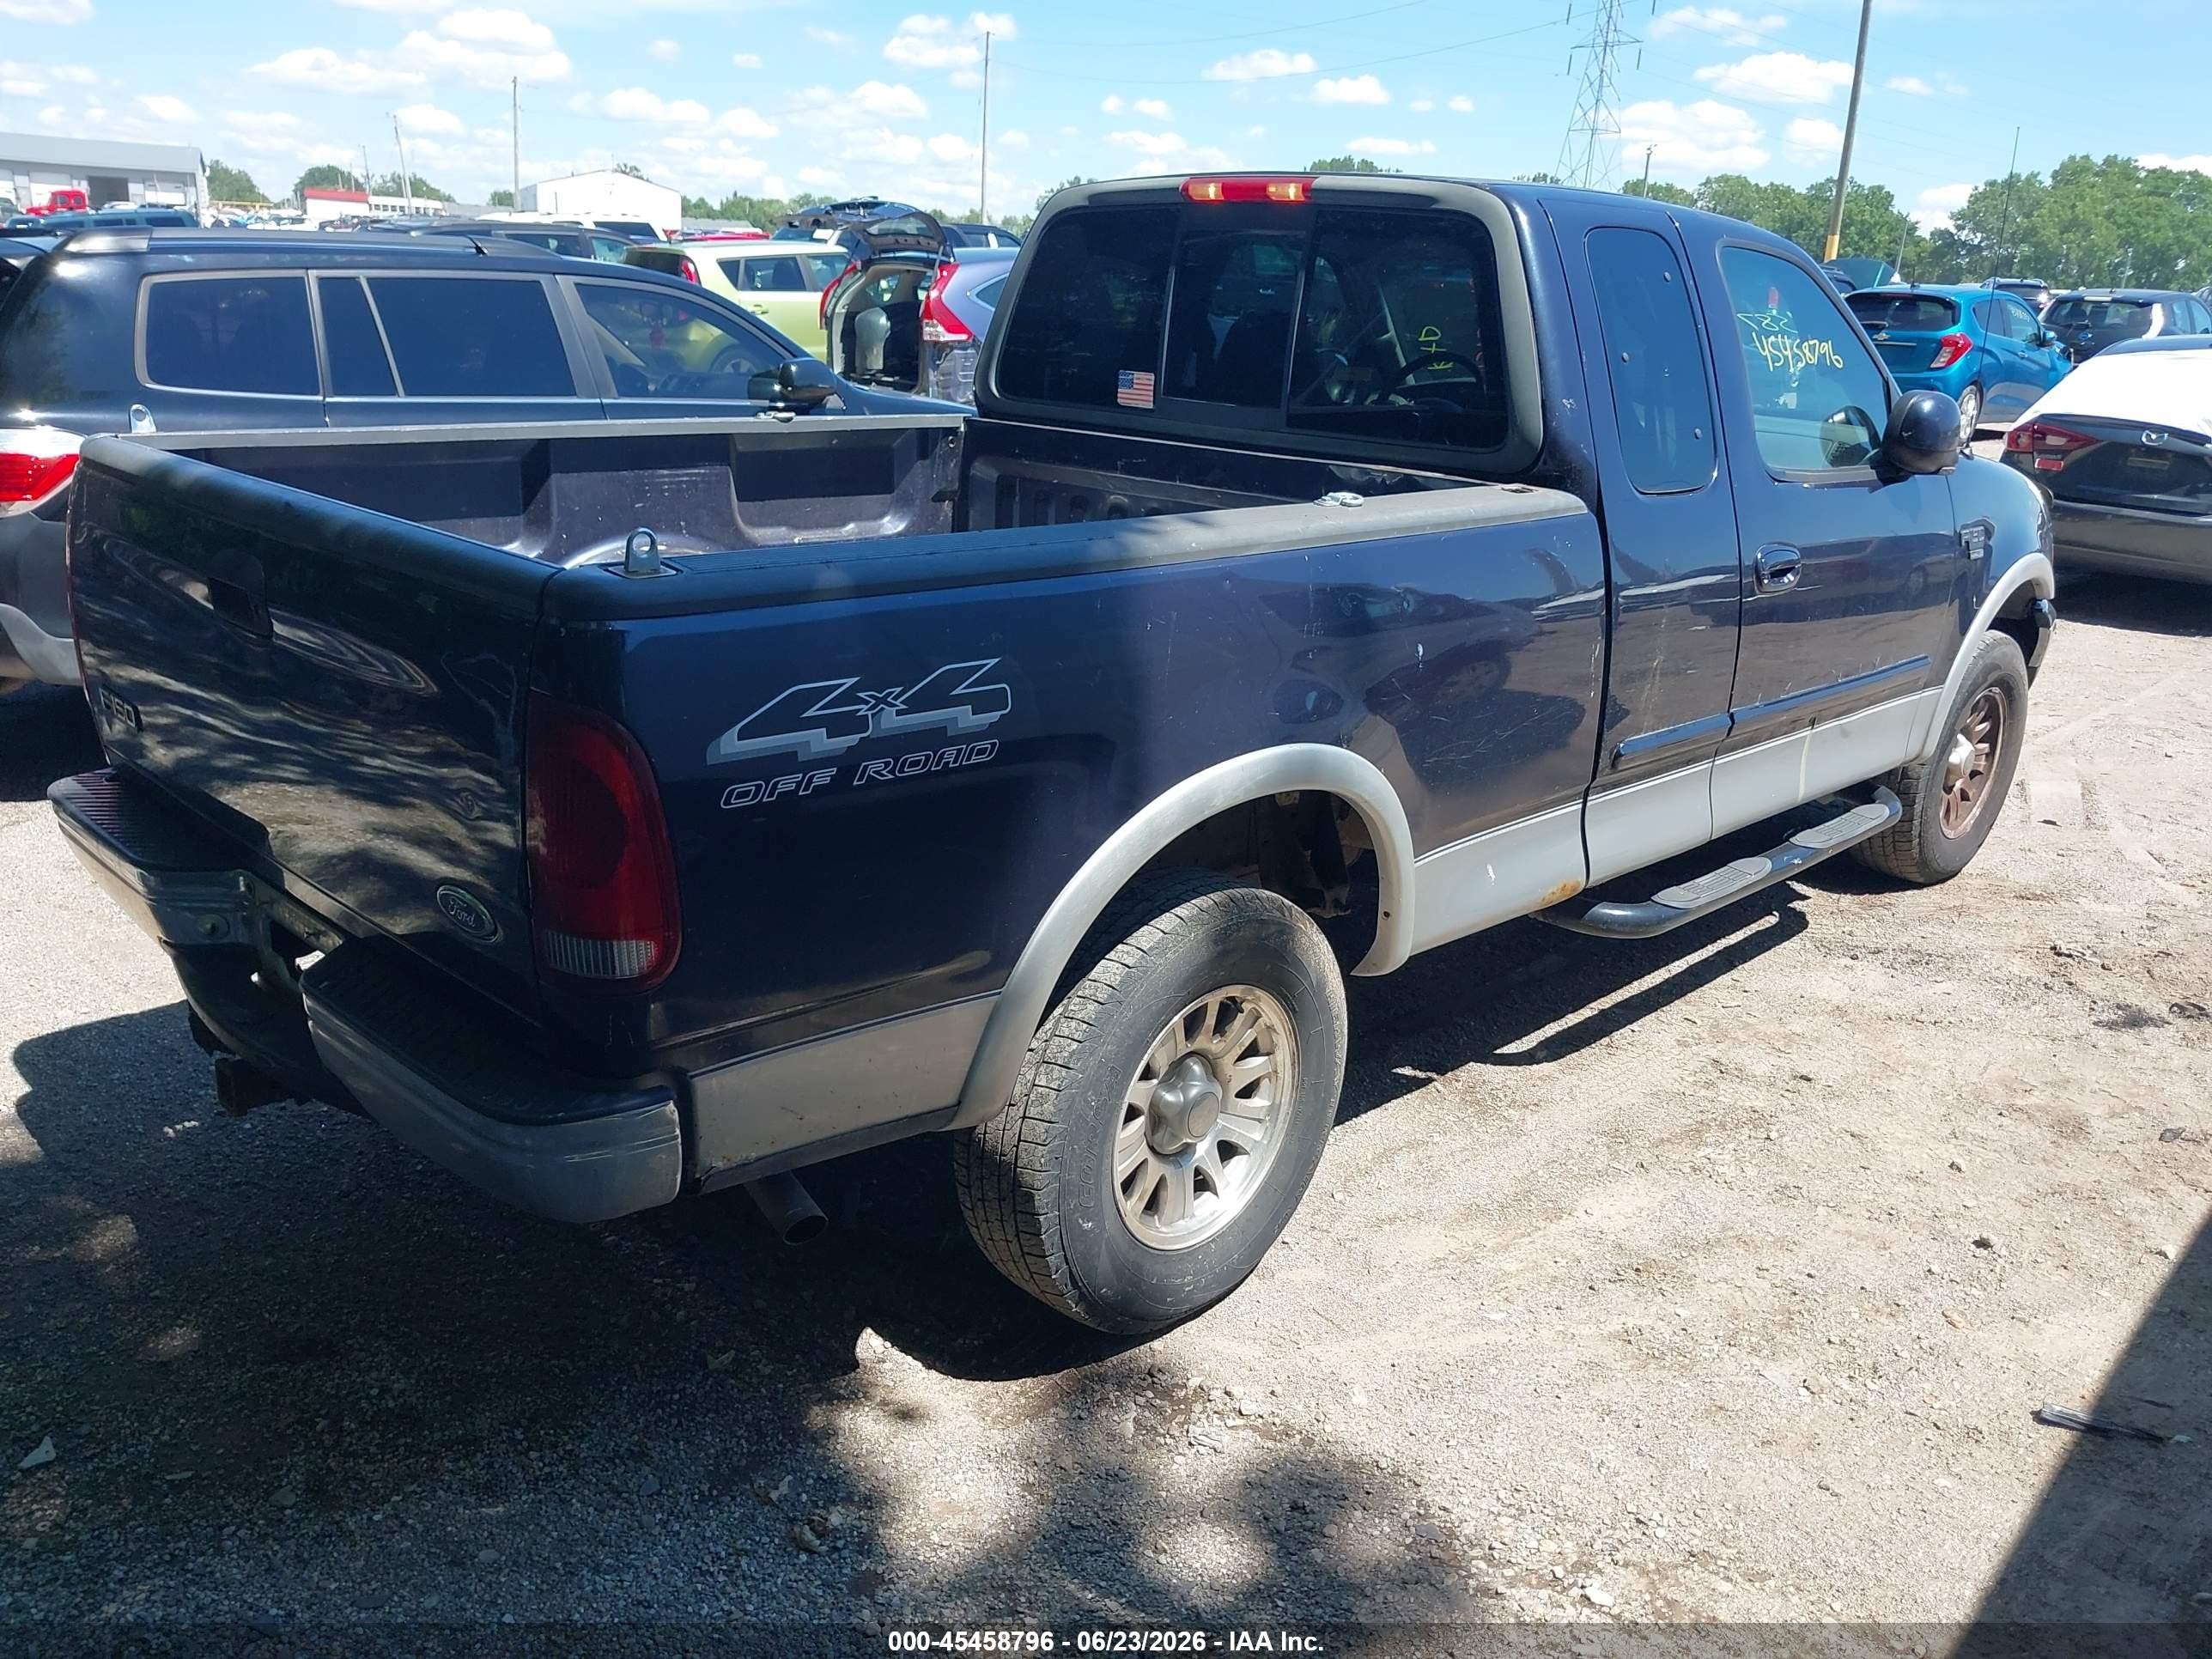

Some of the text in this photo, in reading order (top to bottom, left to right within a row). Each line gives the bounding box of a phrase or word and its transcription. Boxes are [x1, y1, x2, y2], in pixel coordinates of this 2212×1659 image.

[1752, 331, 1843, 371] 45458796
[720, 739, 1000, 809] OFF ROAD
